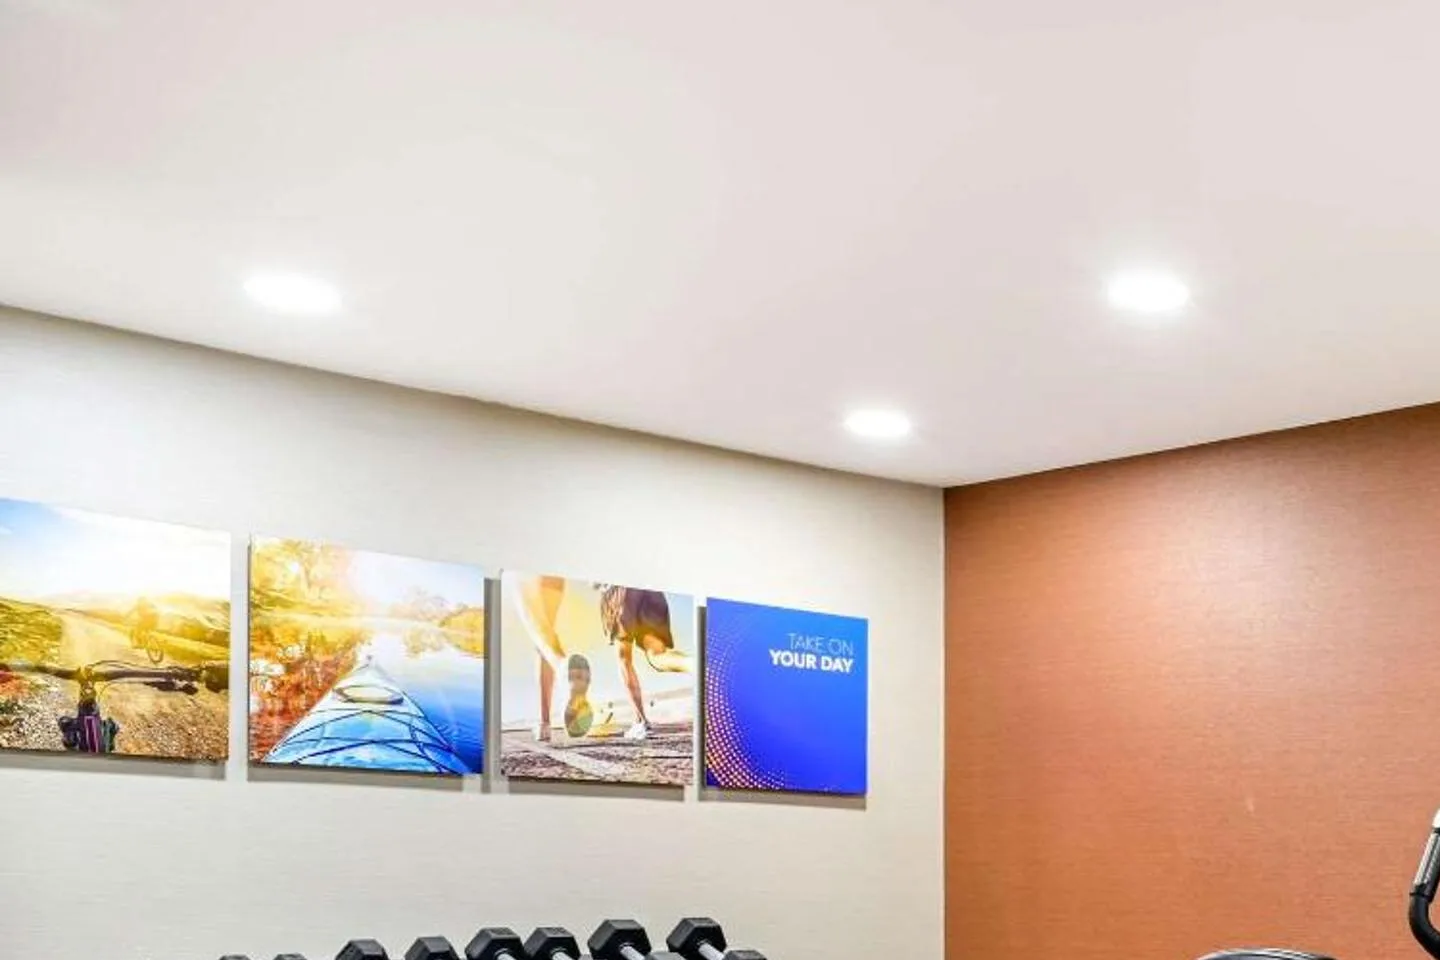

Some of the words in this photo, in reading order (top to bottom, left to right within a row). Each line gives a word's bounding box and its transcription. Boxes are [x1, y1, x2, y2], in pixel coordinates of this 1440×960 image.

[786, 632, 825, 653] TAKE
[828, 638, 855, 656] ON
[768, 648, 817, 670] YOUR
[820, 655, 855, 673] DAY
